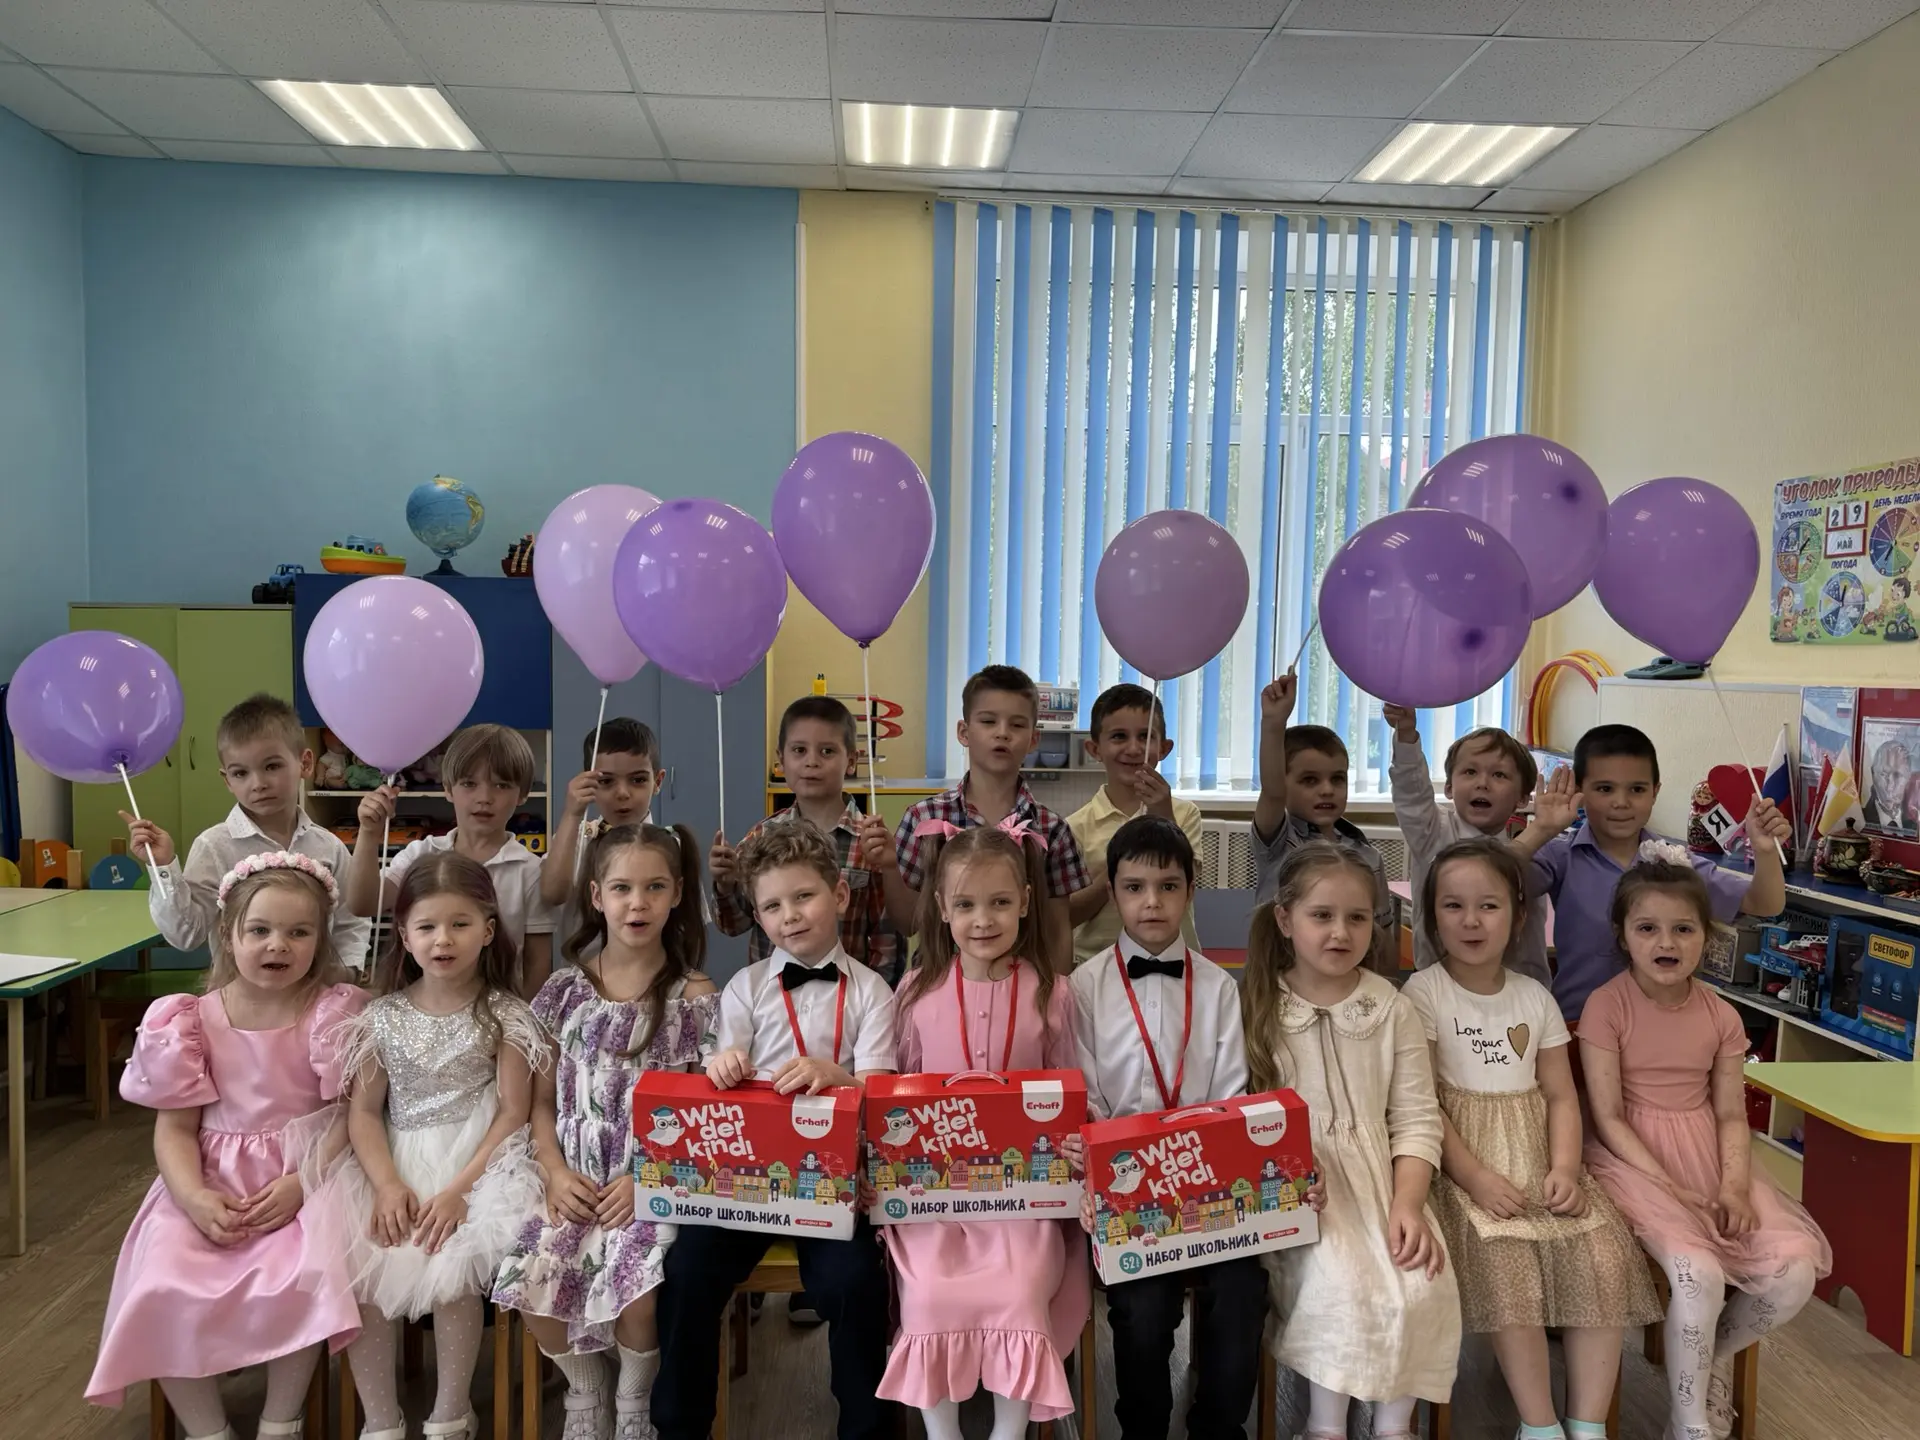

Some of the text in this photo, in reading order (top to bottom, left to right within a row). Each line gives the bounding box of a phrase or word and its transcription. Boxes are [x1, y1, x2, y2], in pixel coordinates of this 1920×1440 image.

[1782, 477, 1841, 505] УГОЛОК
[1831, 559, 1858, 570] ПОГОДА
[1707, 807, 1732, 837] Я
[1873, 941, 1910, 961] СВЕТОФОР
[1453, 1017, 1483, 1036] Love
[1472, 1039, 1504, 1054] your
[1484, 1050, 1511, 1065] Life
[679, 1102, 744, 1128] Wun
[912, 1097, 975, 1124] Wun
[1026, 1101, 1060, 1111] Erhaft
[700, 1118, 745, 1140] der
[795, 1116, 830, 1128] Erhaft
[933, 1110, 978, 1136] der
[1250, 1121, 1284, 1135] Erhaft
[1138, 1130, 1201, 1167] Wun
[1160, 1144, 1204, 1176] der
[675, 1203, 713, 1218] НАБОР
[717, 1208, 791, 1227] ШКОЛЬНИКА
[911, 1201, 949, 1215] НАБОР
[953, 1199, 1026, 1213] ШКОЛЬНИКА
[1145, 1248, 1183, 1268] НАБОР
[1187, 1232, 1260, 1258] ШКОЛЬНИКА
